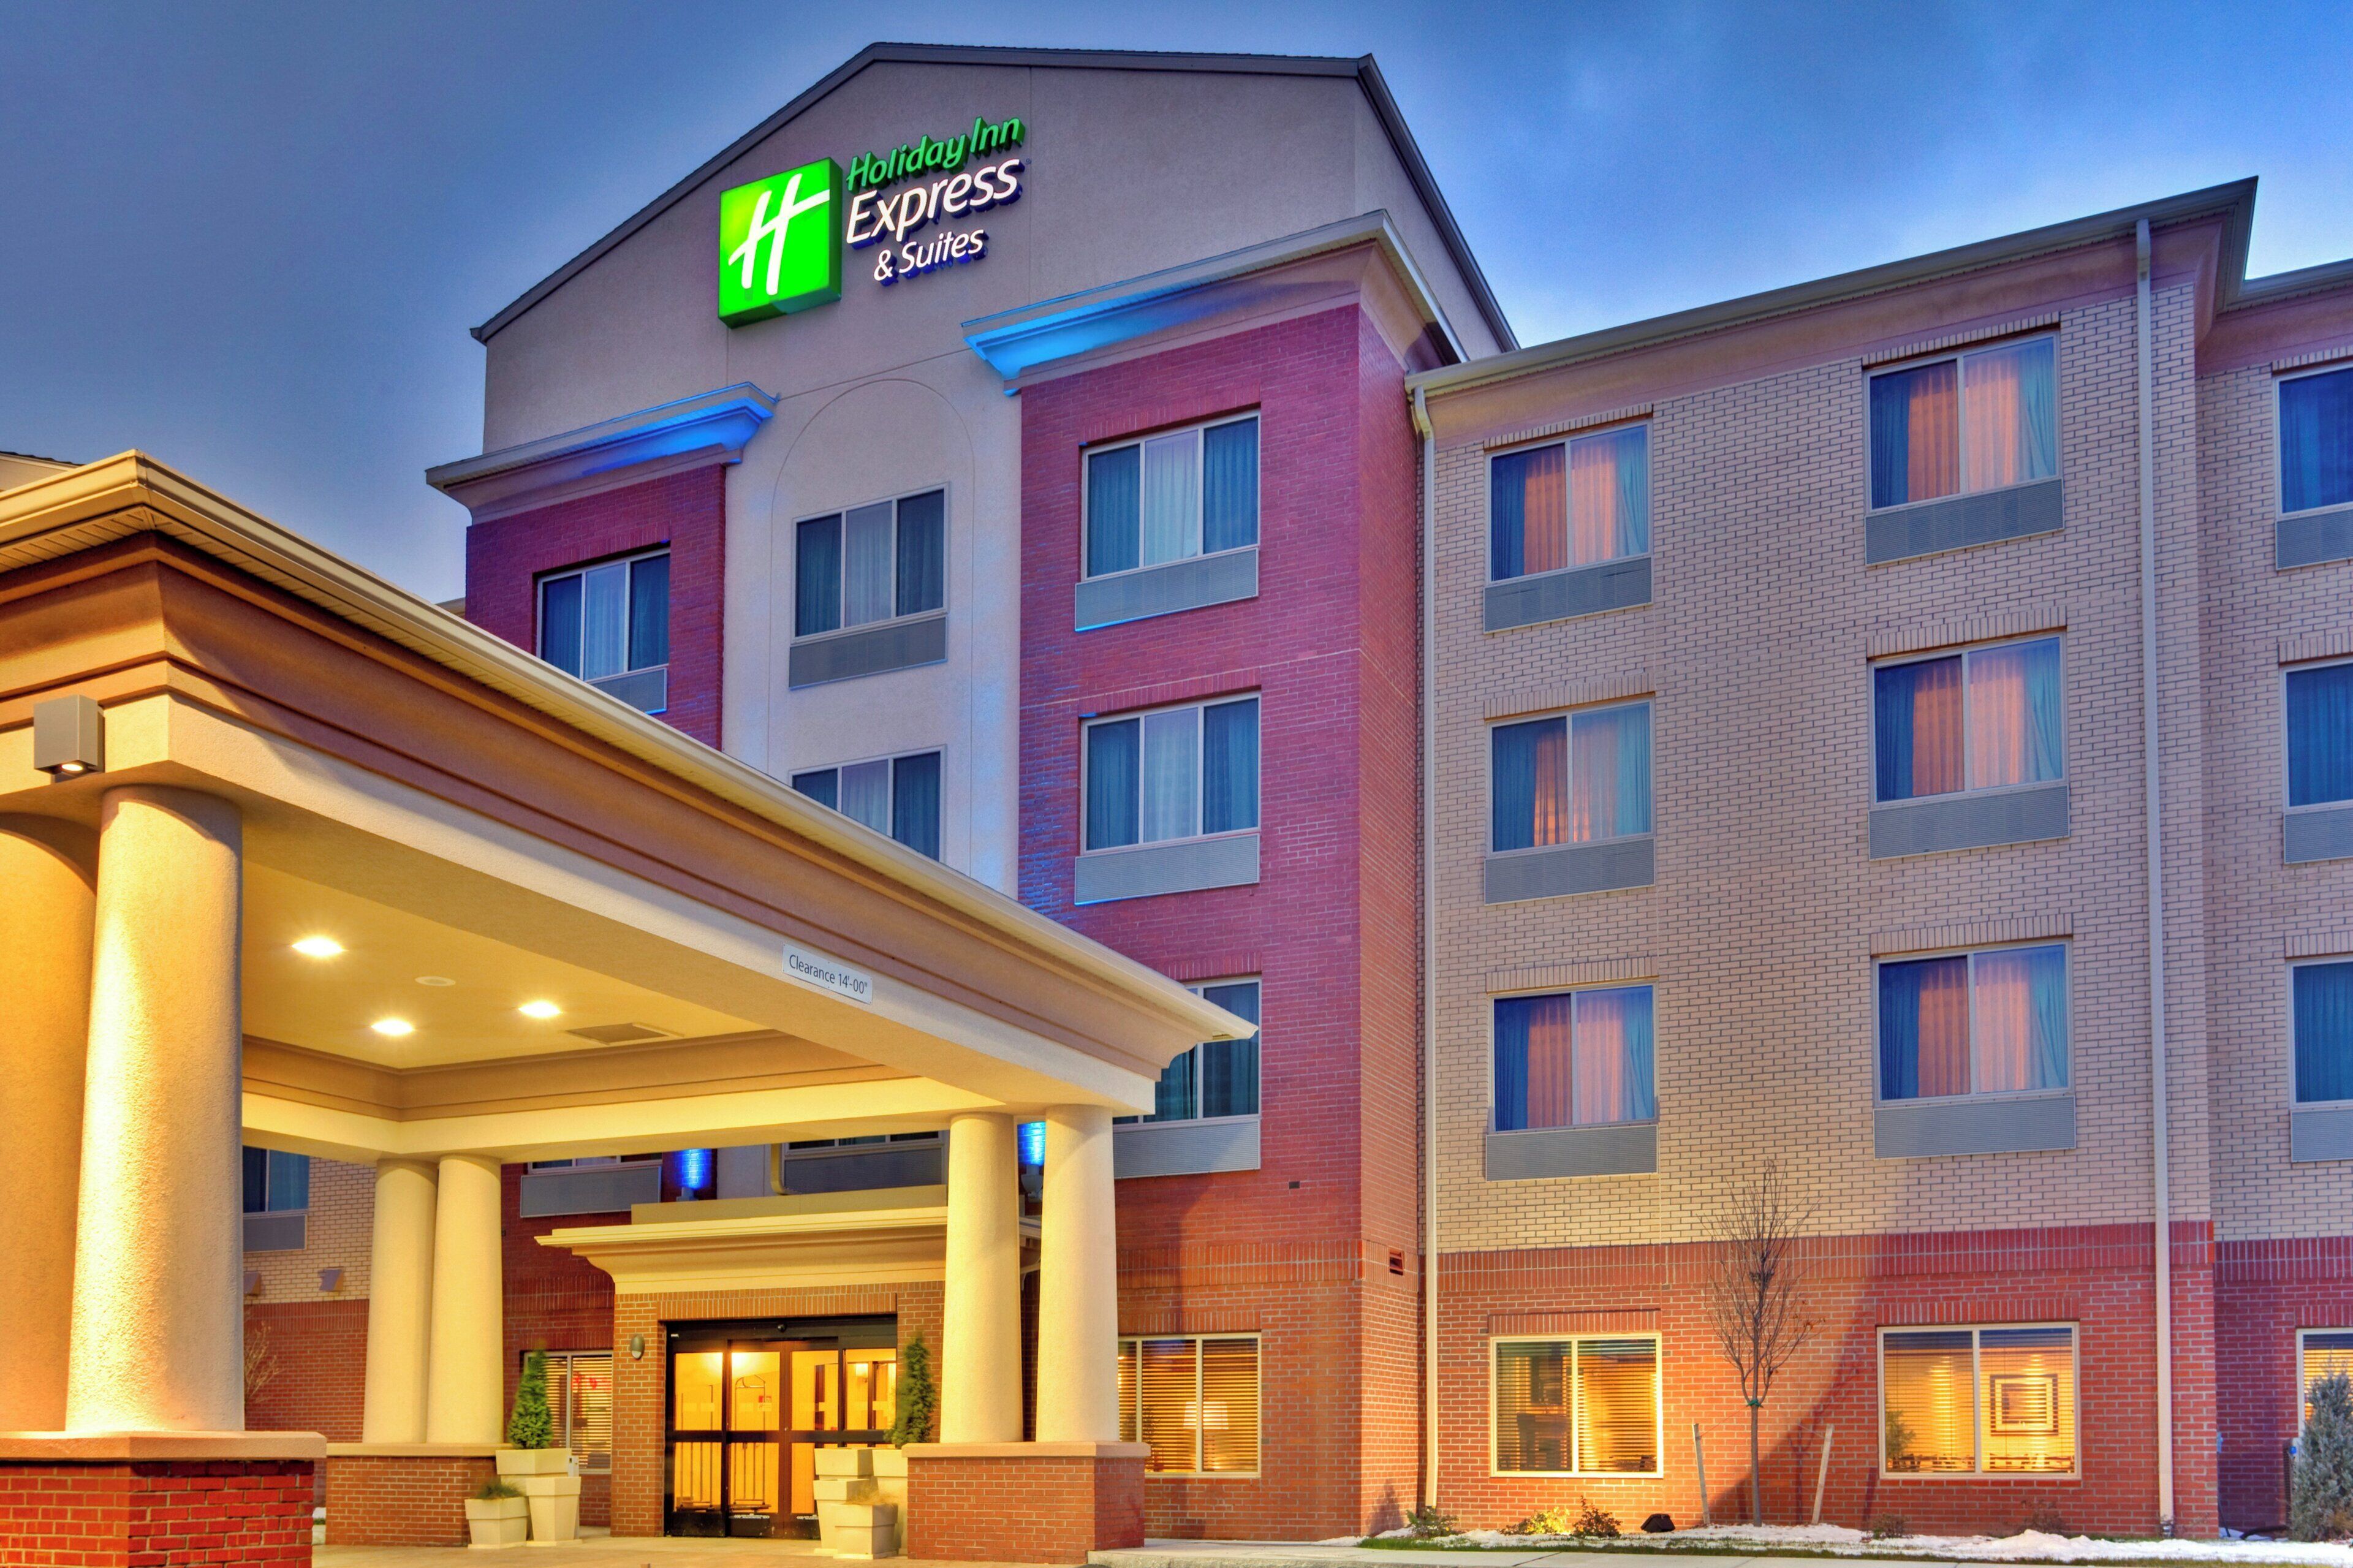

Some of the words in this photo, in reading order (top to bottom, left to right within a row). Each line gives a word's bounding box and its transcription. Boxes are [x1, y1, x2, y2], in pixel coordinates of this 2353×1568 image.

[846, 134, 967, 191] Holiday
[970, 116, 1020, 153] Inn
[846, 159, 1020, 244] Express
[873, 249, 893, 282] &
[898, 229, 985, 274] Suites
[789, 954, 836, 984] Clearance
